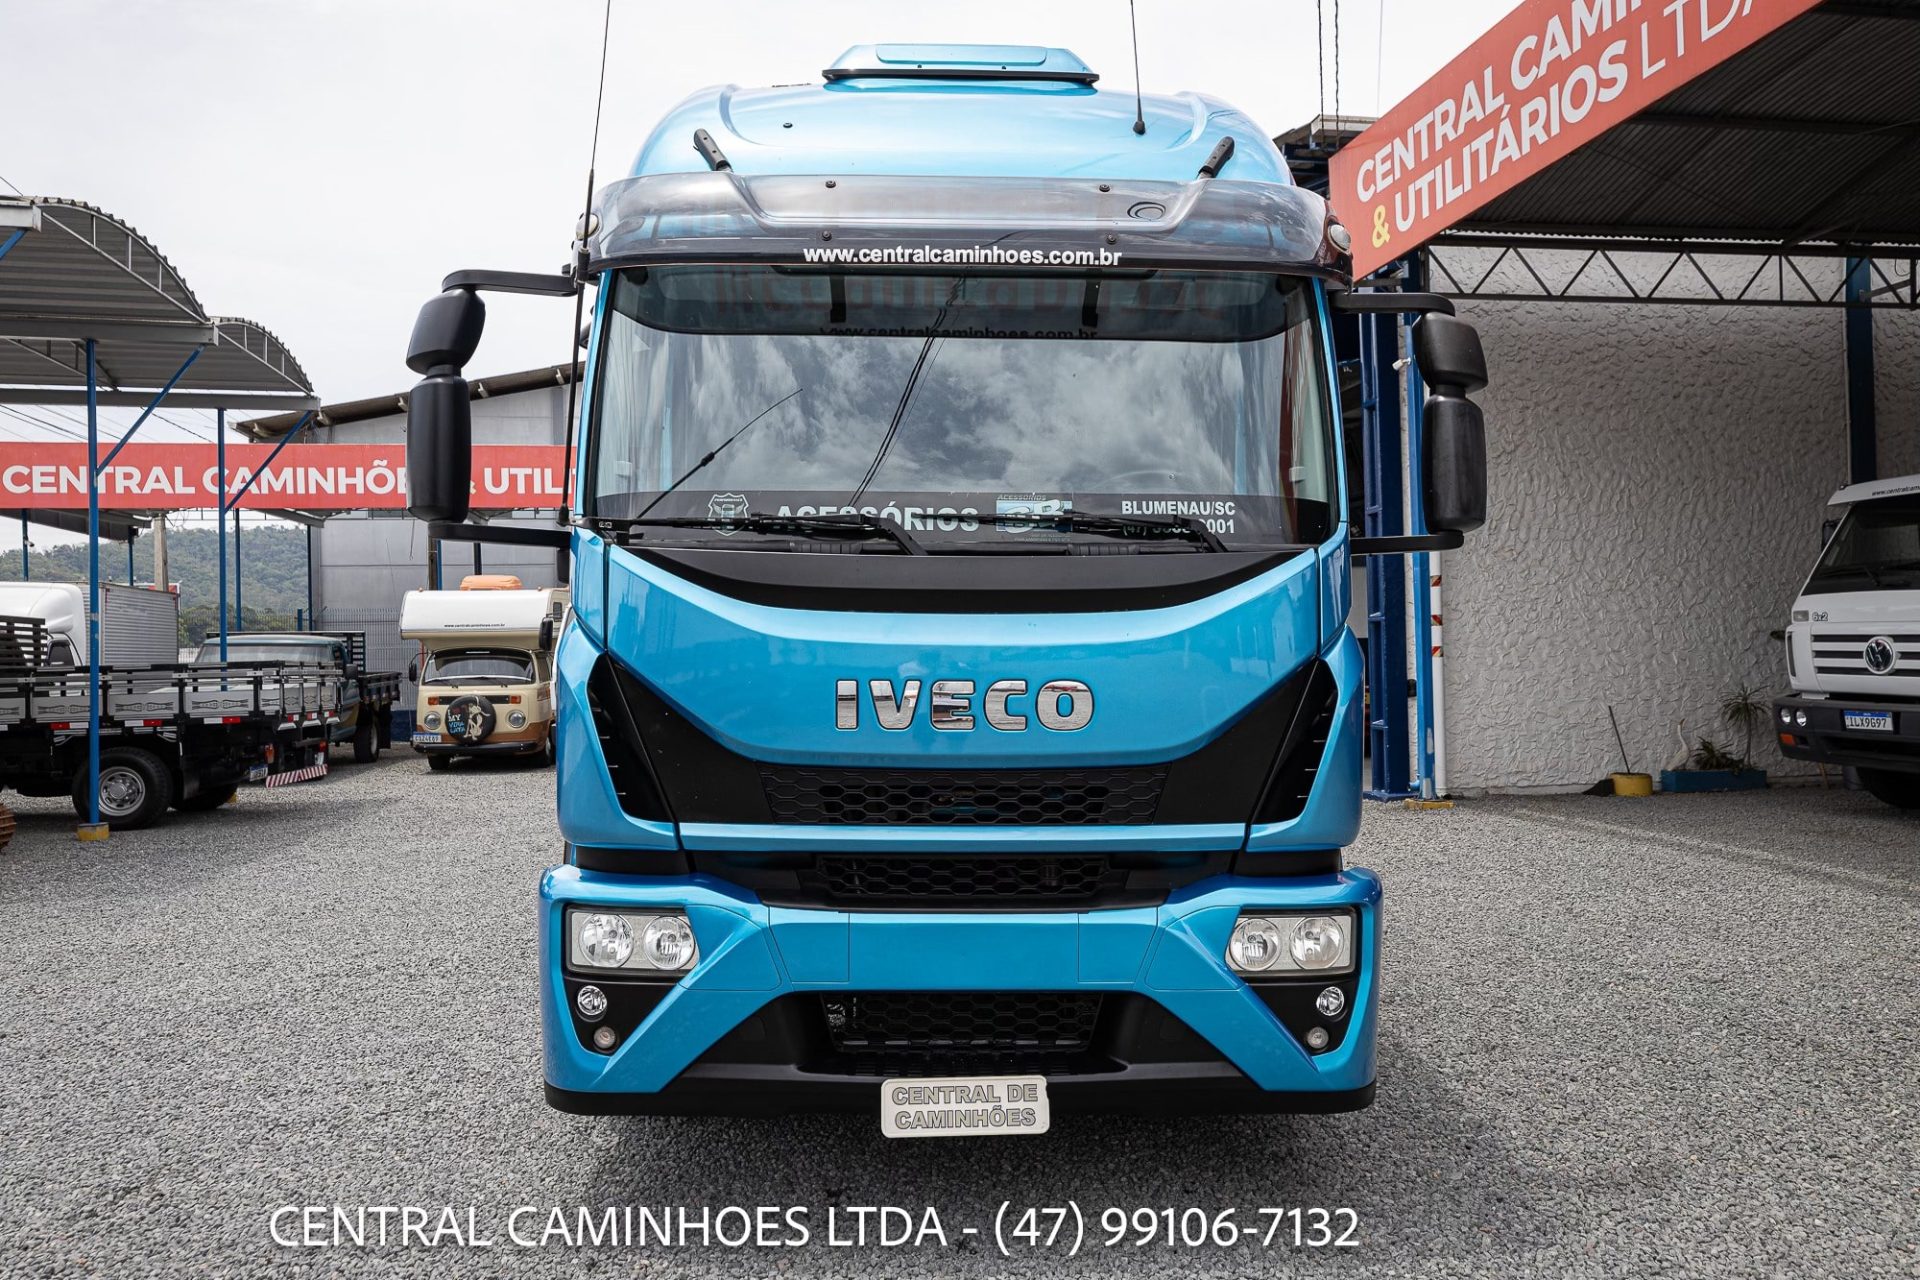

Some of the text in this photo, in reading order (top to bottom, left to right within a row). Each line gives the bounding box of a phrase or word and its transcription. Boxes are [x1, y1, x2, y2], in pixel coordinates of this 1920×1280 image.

[1357, 0, 1642, 203] CENTRAL CAM
[1372, 0, 1753, 248] & UTILITÁRIOS LTD
[803, 245, 1122, 266] www.centralcaminhoes.com.br
[2, 459, 407, 495] CENTRAL CAMINHÕ
[484, 467, 577, 495] UTIL
[1121, 500, 1236, 516] BLUMENAU/SC
[835, 678, 1096, 731] IVECO
[892, 1084, 1038, 1105] CENTRAL DE
[895, 1105, 1036, 1129] CAMINHÕES
